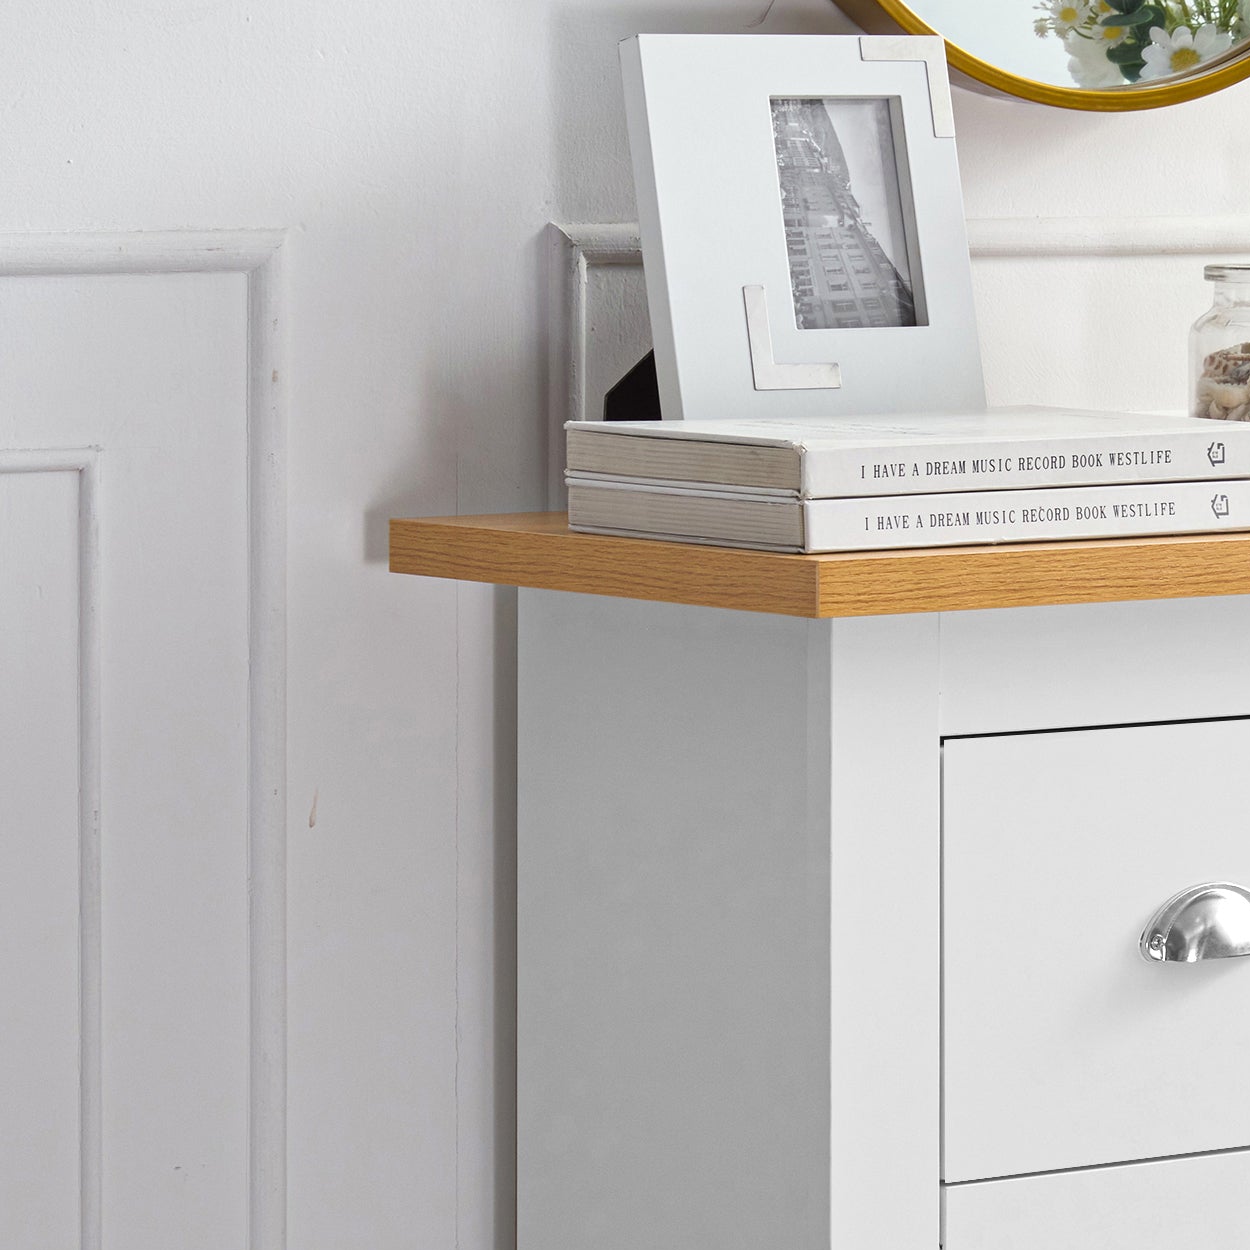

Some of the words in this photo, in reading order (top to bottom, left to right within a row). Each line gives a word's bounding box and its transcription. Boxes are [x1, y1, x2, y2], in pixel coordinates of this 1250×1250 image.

[861, 465, 866, 479] I
[873, 463, 906, 479] HAVE
[912, 463, 920, 477] A
[926, 460, 966, 476] DREAM
[972, 458, 1012, 473] MUSIC
[1018, 455, 1066, 471] RECORD
[1072, 453, 1103, 469] BOOK
[1109, 450, 1172, 466] WESTLIFE
[865, 517, 869, 531] I
[877, 515, 910, 531] HAVE
[916, 515, 923, 528] A
[930, 512, 970, 528] DREAM
[976, 510, 1016, 526] MUSIC
[1022, 506, 1070, 523] RECORD
[1076, 505, 1107, 521] BOOK
[1113, 502, 1176, 518] WESTLIFE
